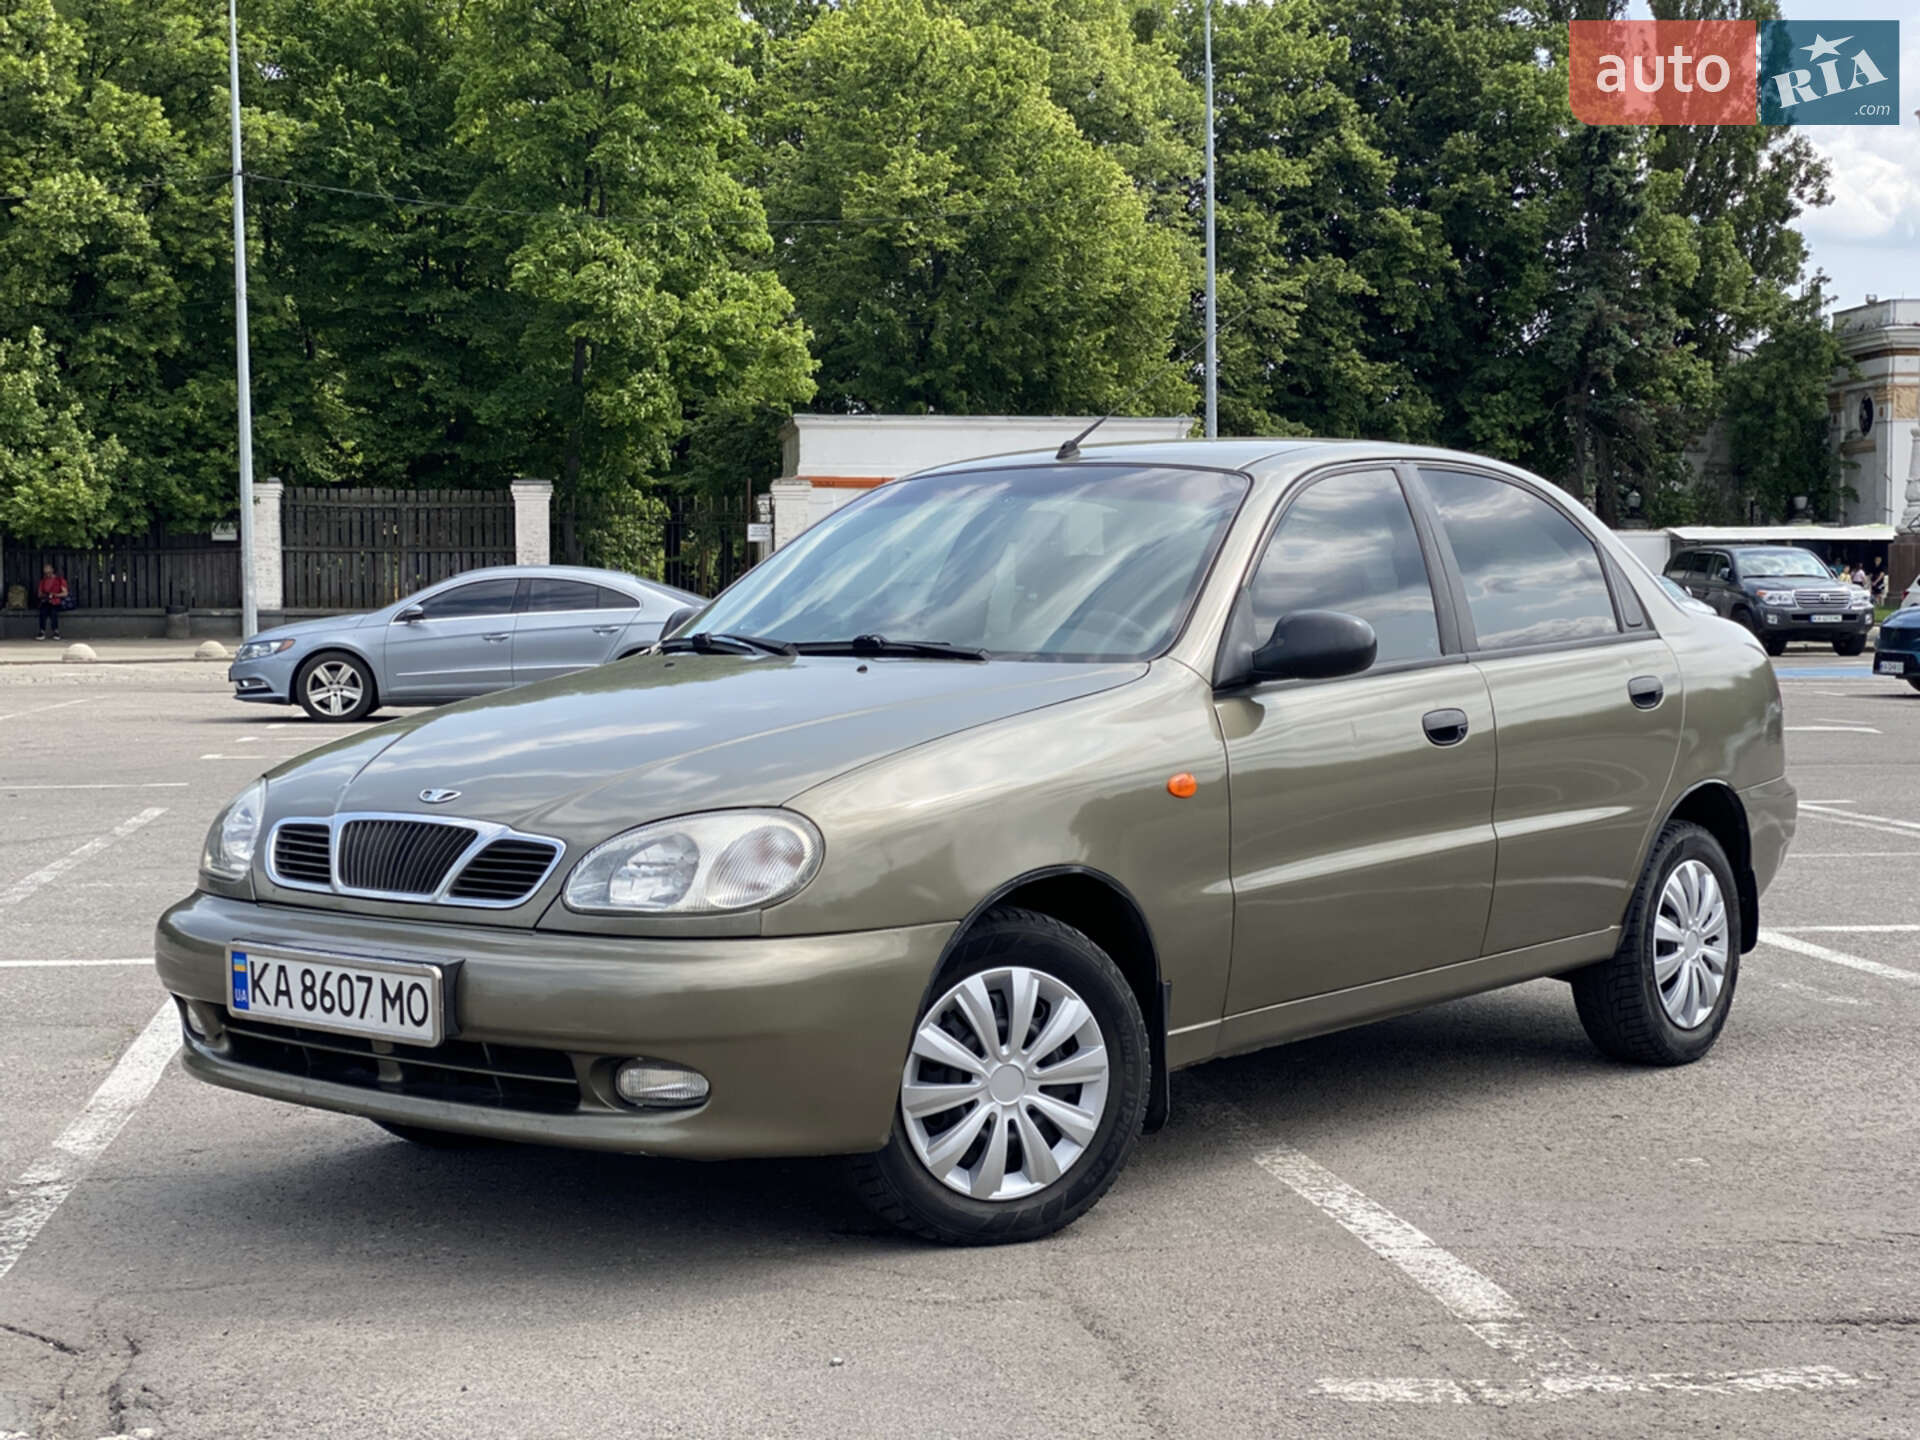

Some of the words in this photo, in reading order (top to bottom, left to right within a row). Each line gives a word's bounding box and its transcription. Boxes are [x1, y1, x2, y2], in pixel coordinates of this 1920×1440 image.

[234, 987, 248, 1002] UA
[249, 960, 294, 1009] KA
[301, 968, 373, 1019] 8607
[381, 976, 429, 1028] MO
